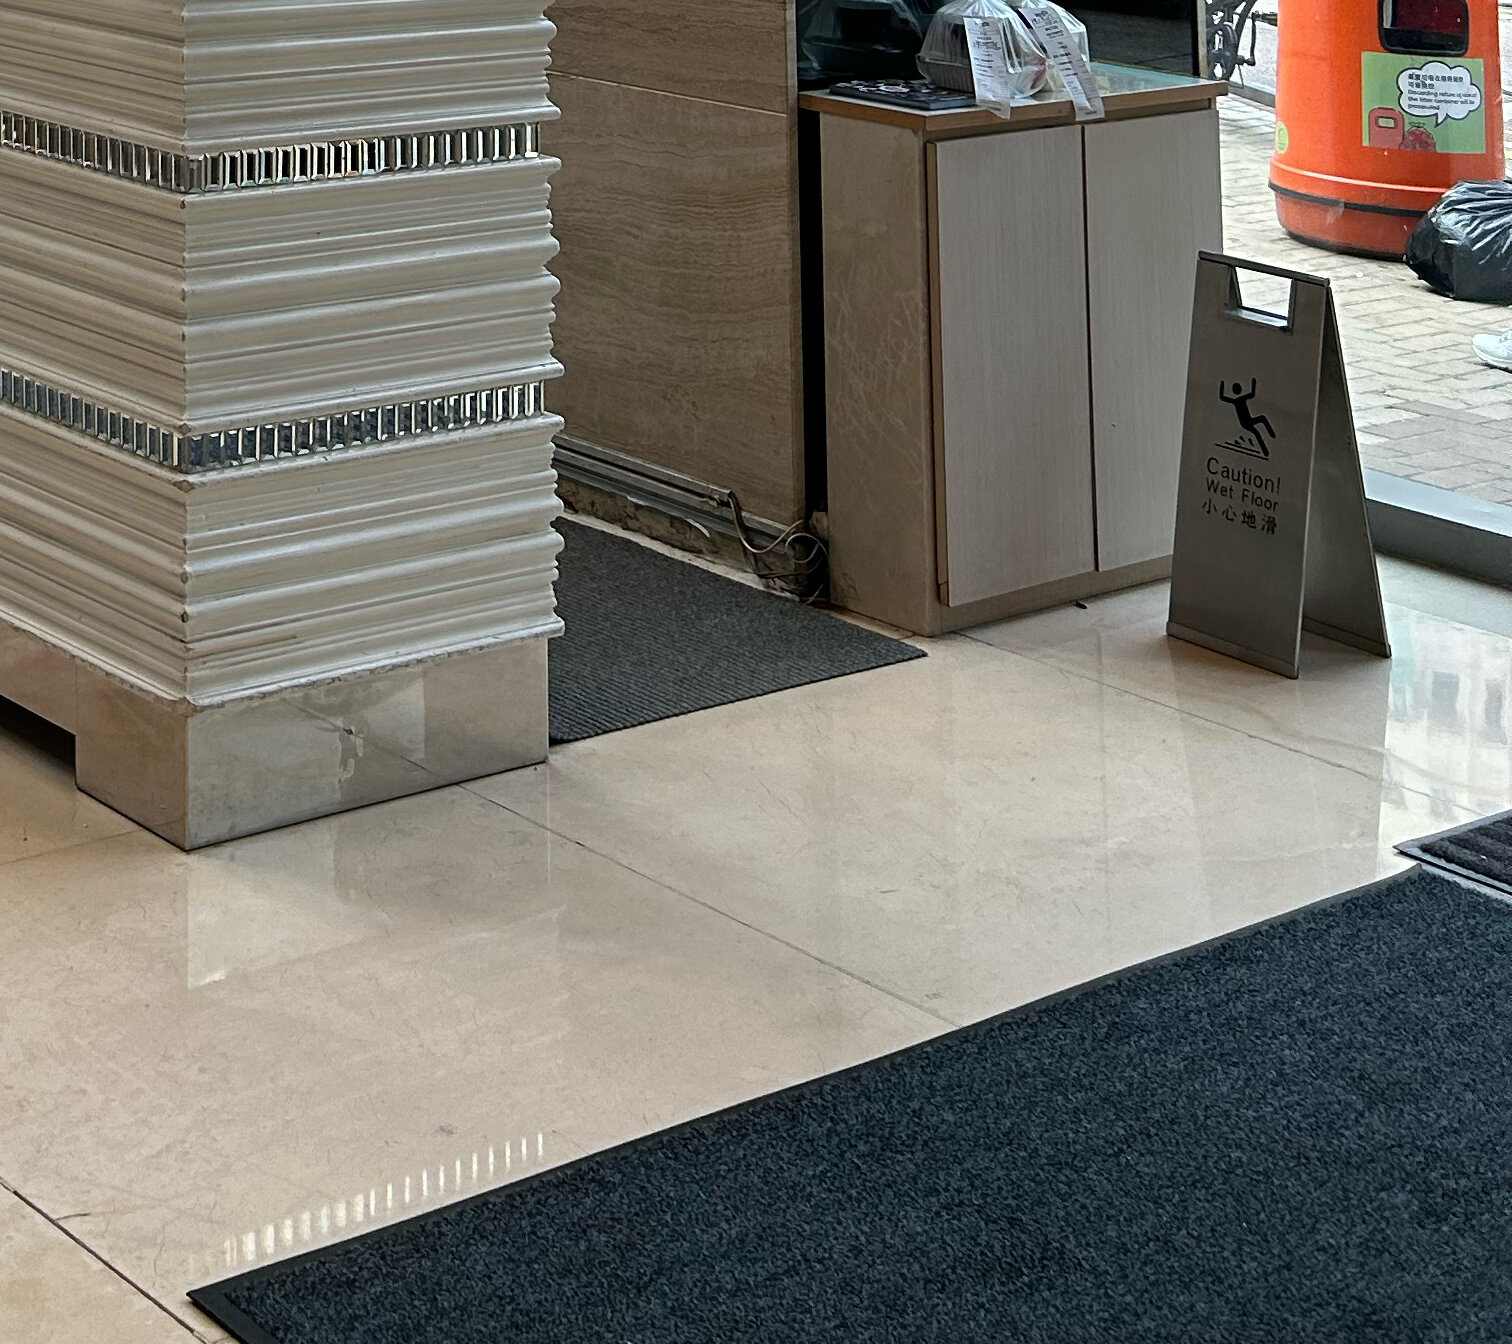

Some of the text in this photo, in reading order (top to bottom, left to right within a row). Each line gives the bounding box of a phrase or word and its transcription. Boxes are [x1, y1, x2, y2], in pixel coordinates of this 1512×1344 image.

[1206, 456, 1281, 494] Caution!
[1205, 476, 1279, 512] Wet Floor
[1201, 498, 1277, 535] 小心地滑
